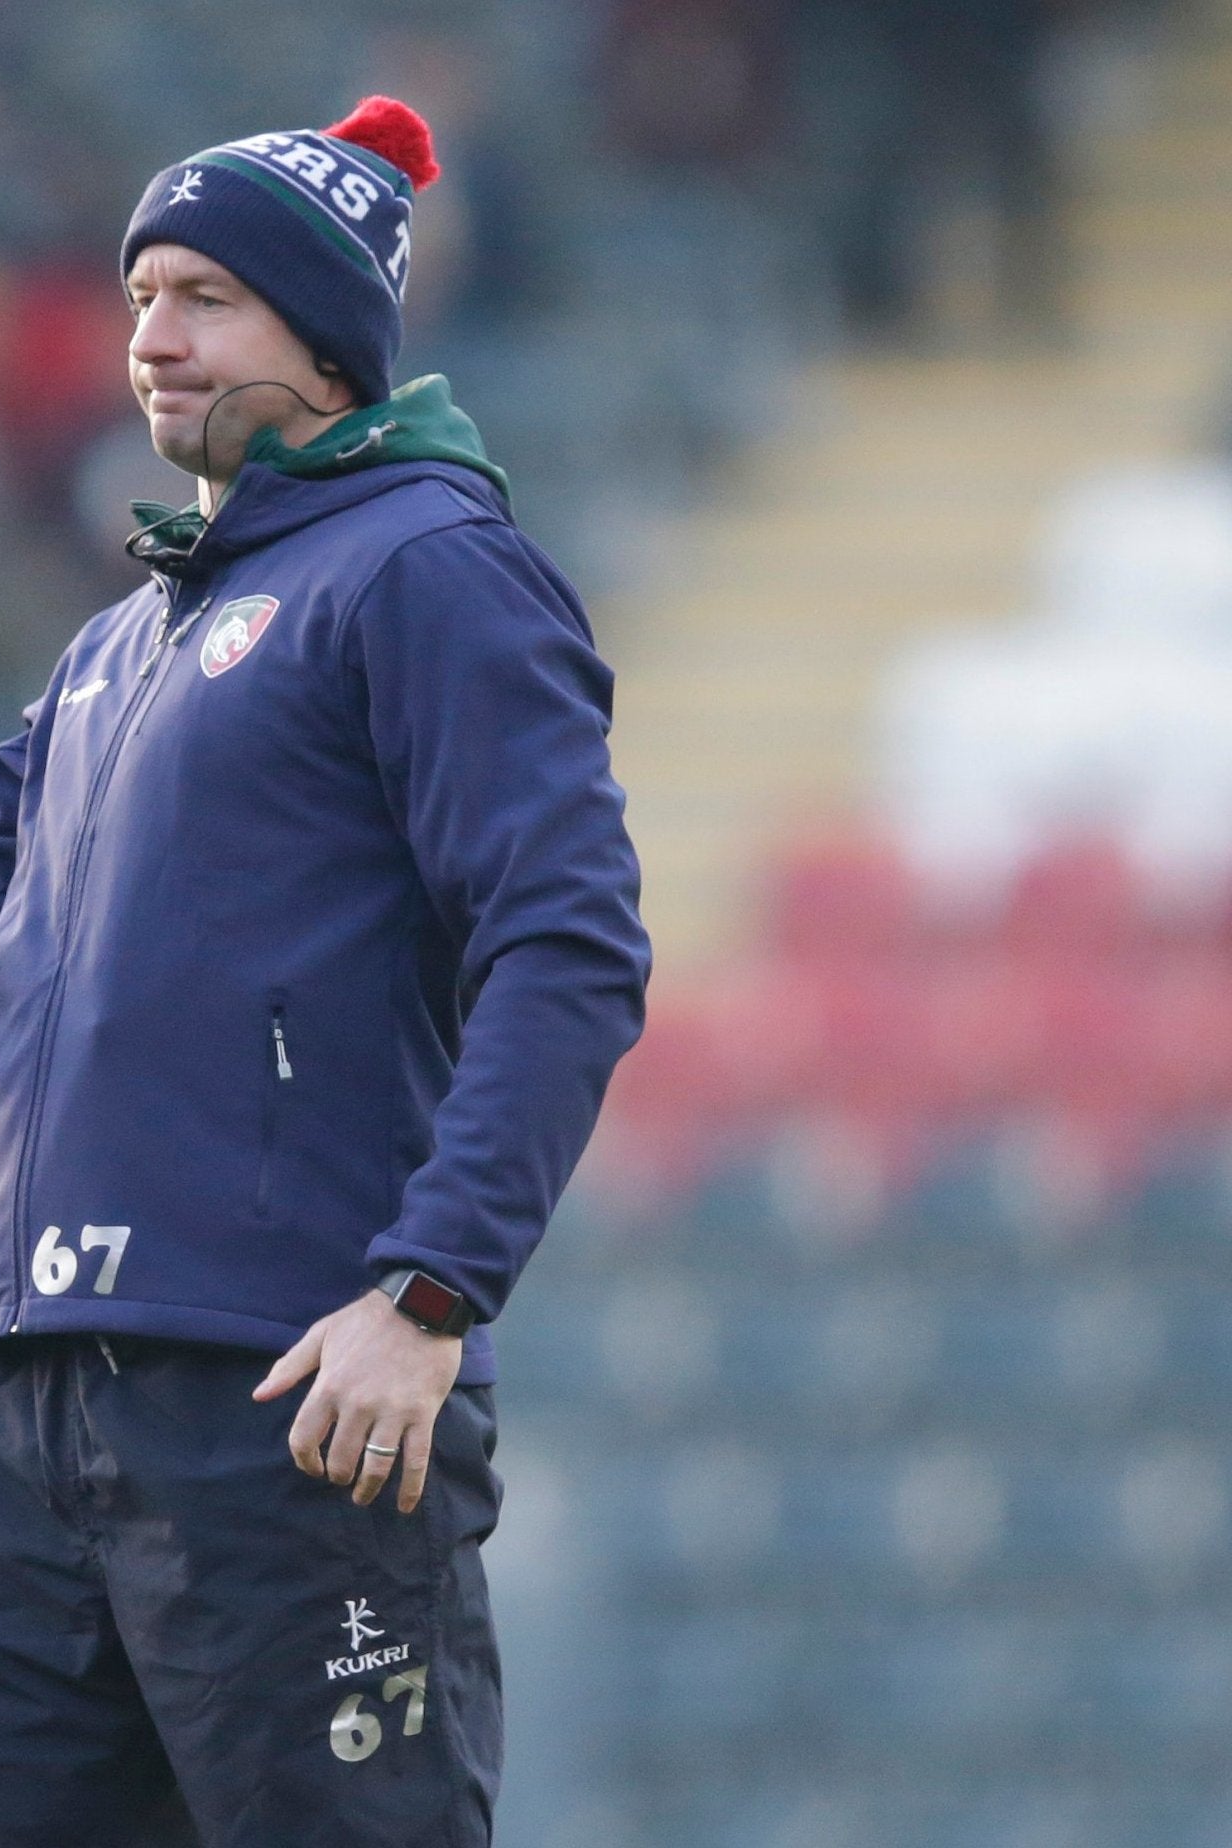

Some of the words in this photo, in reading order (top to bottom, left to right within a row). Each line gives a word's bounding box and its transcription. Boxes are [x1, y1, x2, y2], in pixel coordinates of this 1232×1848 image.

[31, 1223, 132, 1296] 67
[324, 1642, 410, 1681] KUKRI
[329, 1664, 430, 1763] 67
